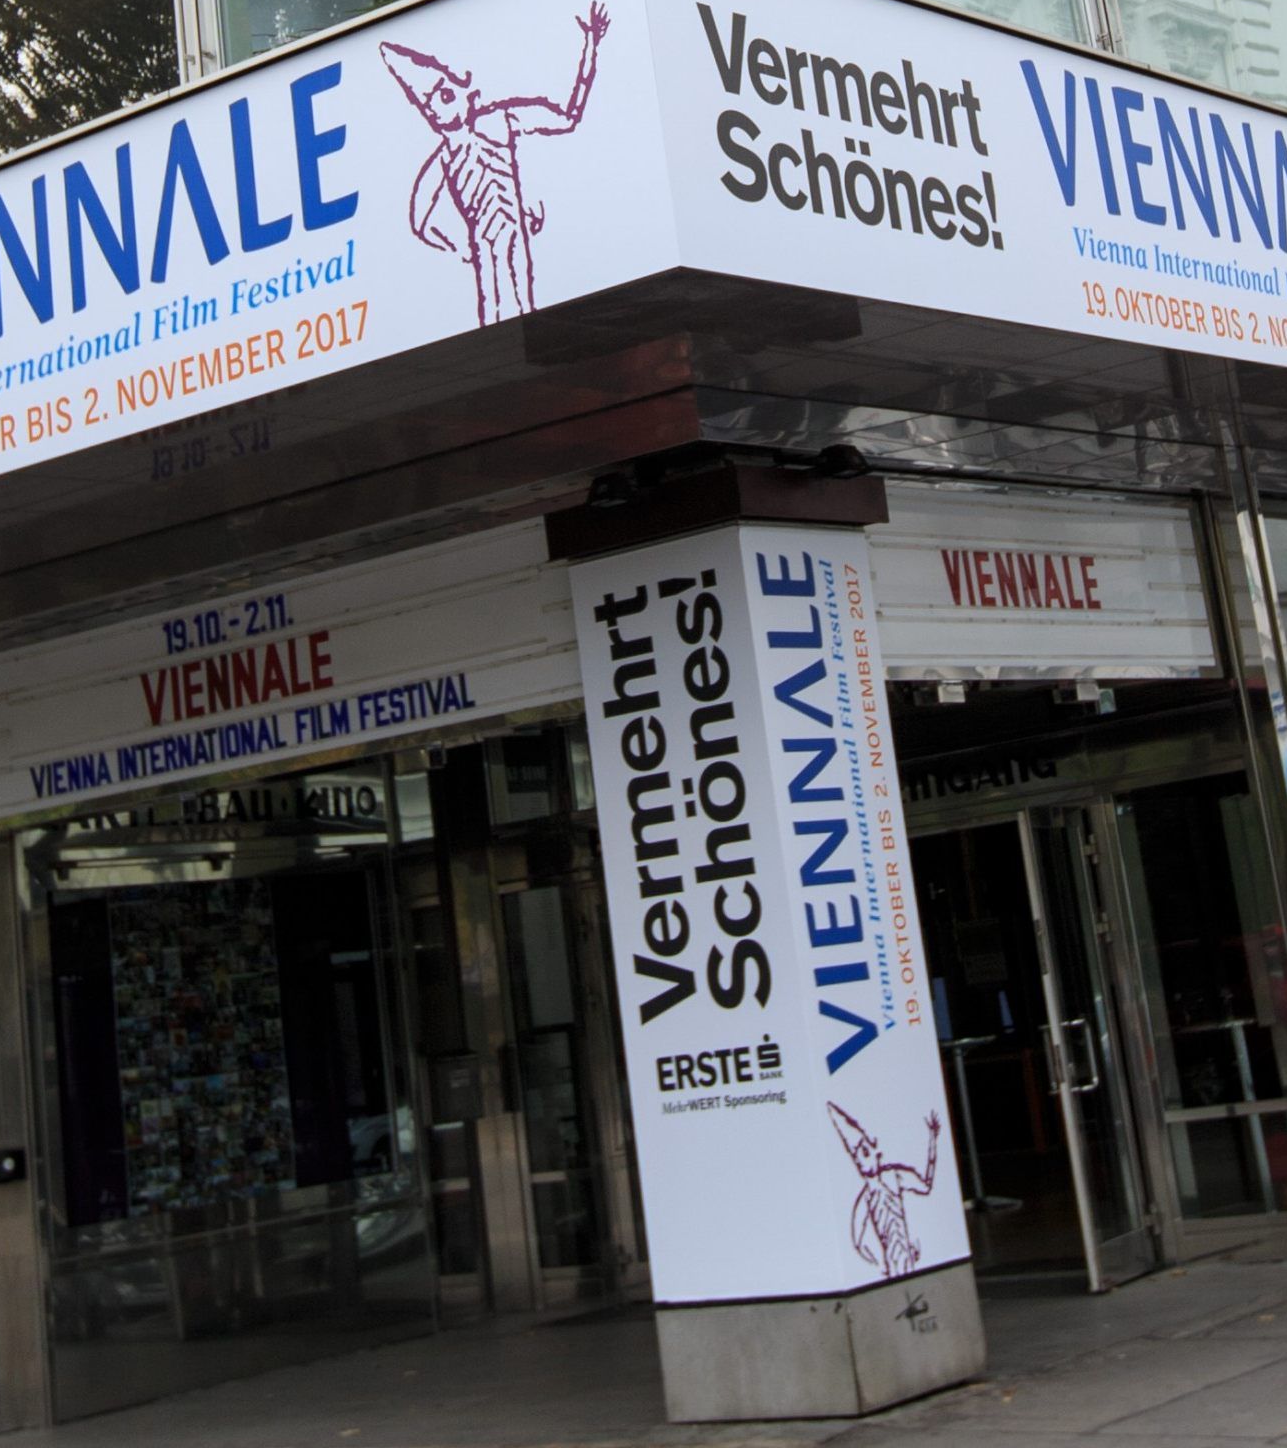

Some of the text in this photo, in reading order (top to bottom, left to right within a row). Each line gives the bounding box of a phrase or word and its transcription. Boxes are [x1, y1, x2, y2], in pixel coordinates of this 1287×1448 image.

[696, 2, 988, 157] Vermehrt
[717, 110, 1004, 250] Schönes!
[153, 294, 219, 342] Film
[231, 240, 357, 311] Festival
[1073, 227, 1148, 271] Vienna
[1154, 243, 1281, 296] International
[1117, 290, 1208, 334] OKTOBER
[1213, 308, 1244, 339] BIS
[1249, 314, 1266, 344] 2.
[27, 400, 72, 443] BIS
[84, 386, 110, 425] 2.
[117, 328, 286, 415] NOVEMBER
[296, 301, 369, 360] 2017
[845, 564, 863, 620] 2017
[942, 549, 1101, 609] VIENNALE
[140, 630, 333, 725] VIENNALE
[853, 628, 882, 767] NOVEMBER
[30, 674, 475, 798] VIENNA INTERNATIONAL FILM FESTIVAL
[874, 777, 888, 797] 2.
[594, 584, 696, 1024] Vermehrt
[658, 568, 771, 1009] Schönes!
[756, 551, 879, 1075] VIENNALE
[819, 560, 897, 1032] Vienna International Film Festival
[881, 810, 896, 851] BIS
[886, 861, 916, 982] OKTOBER
[657, 1046, 753, 1091] ERSTE
[724, 1090, 787, 1110] Sponsoring
[759, 1071, 784, 1080] BANK
